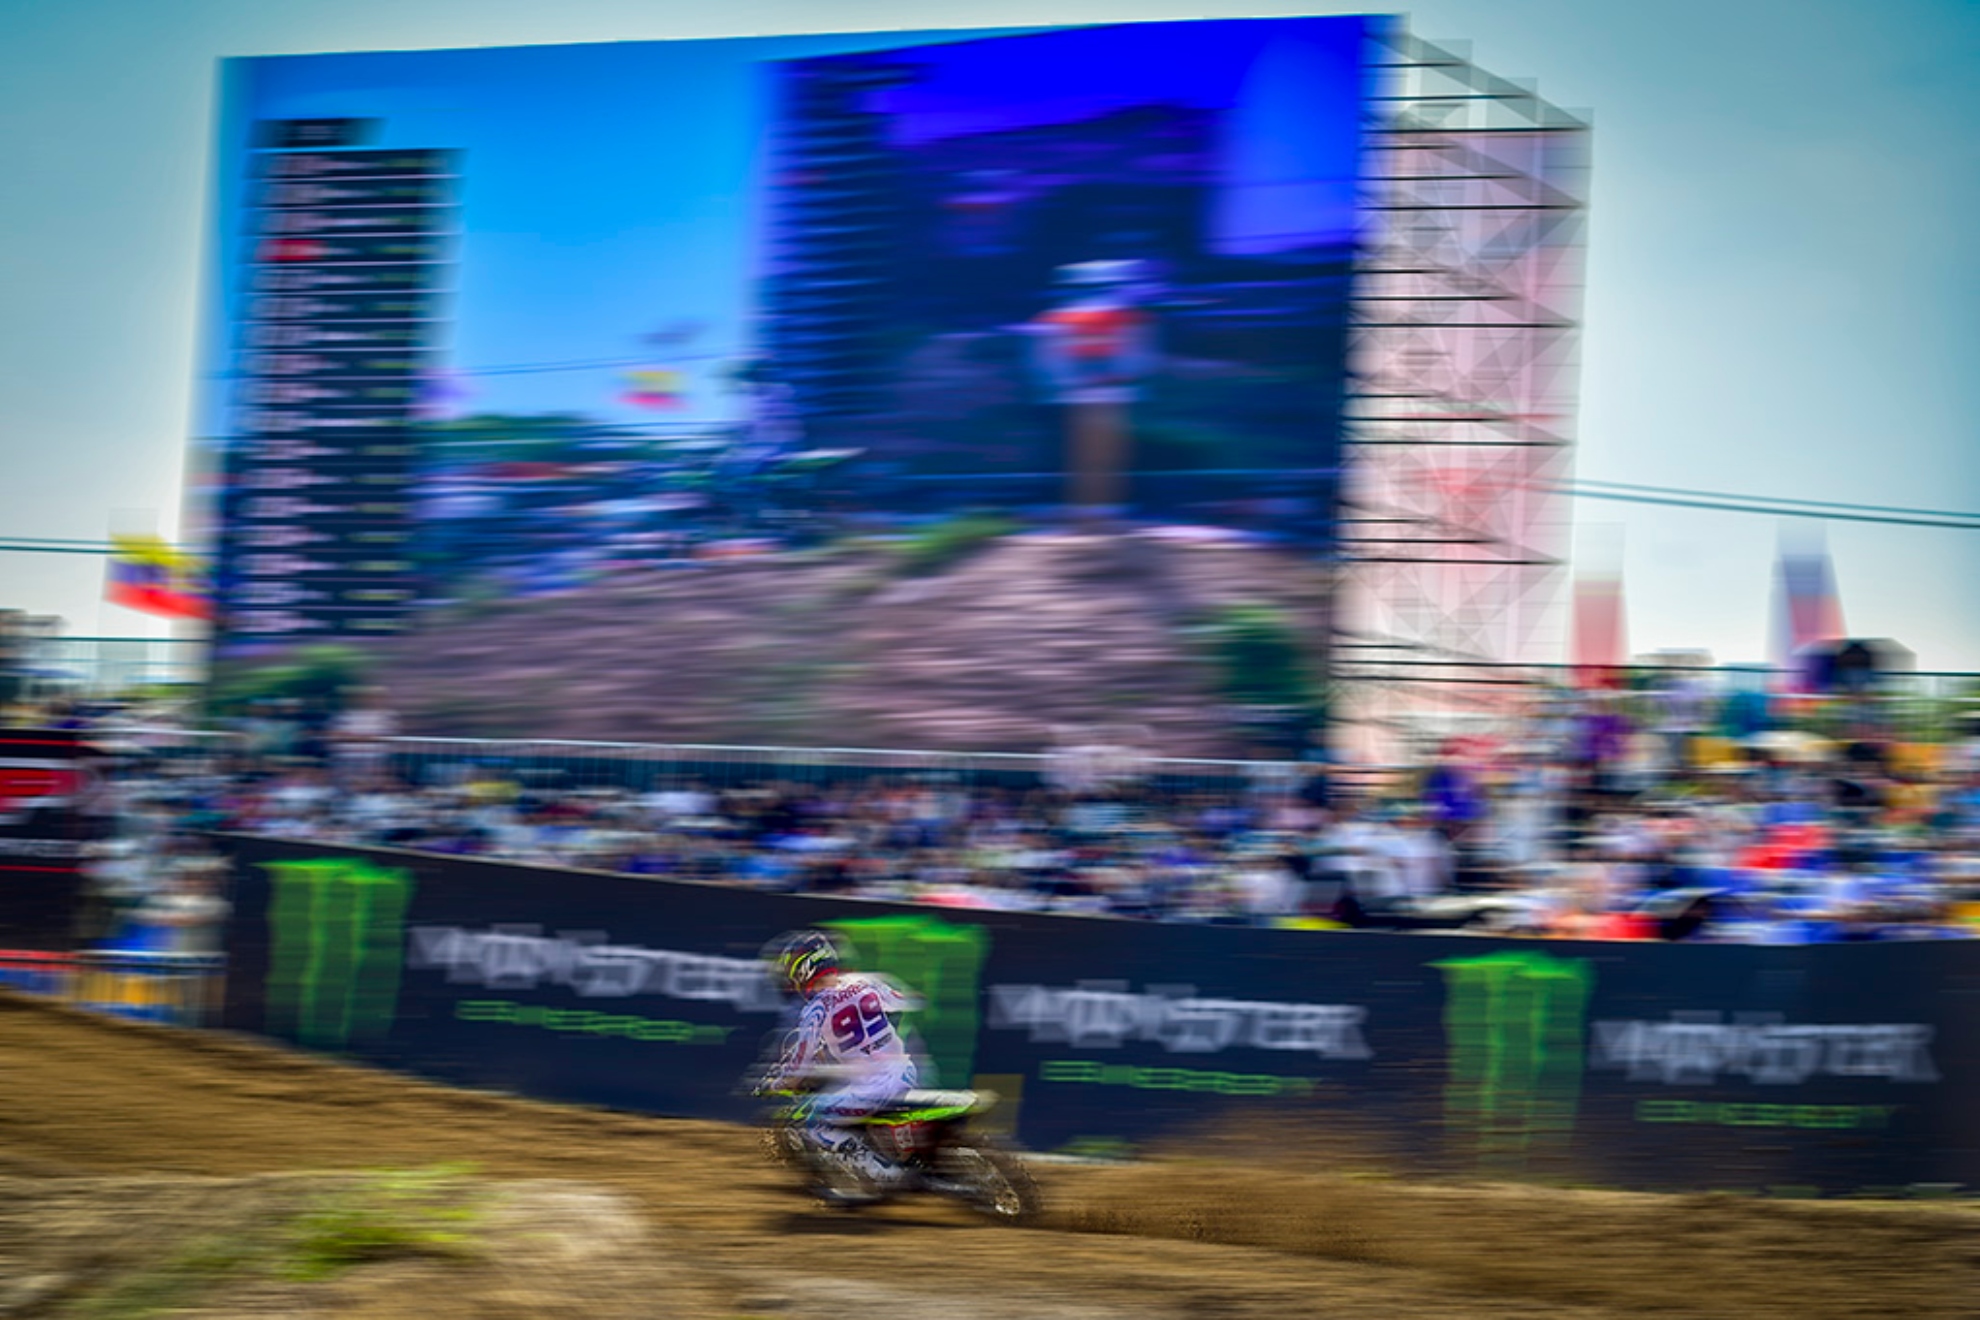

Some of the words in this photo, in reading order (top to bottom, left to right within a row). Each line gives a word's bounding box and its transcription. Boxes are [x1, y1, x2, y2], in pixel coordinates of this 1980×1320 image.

[832, 992, 888, 1053] 99
[988, 979, 1373, 1059] MONSTER
[1590, 1009, 1942, 1085] MONSTER
